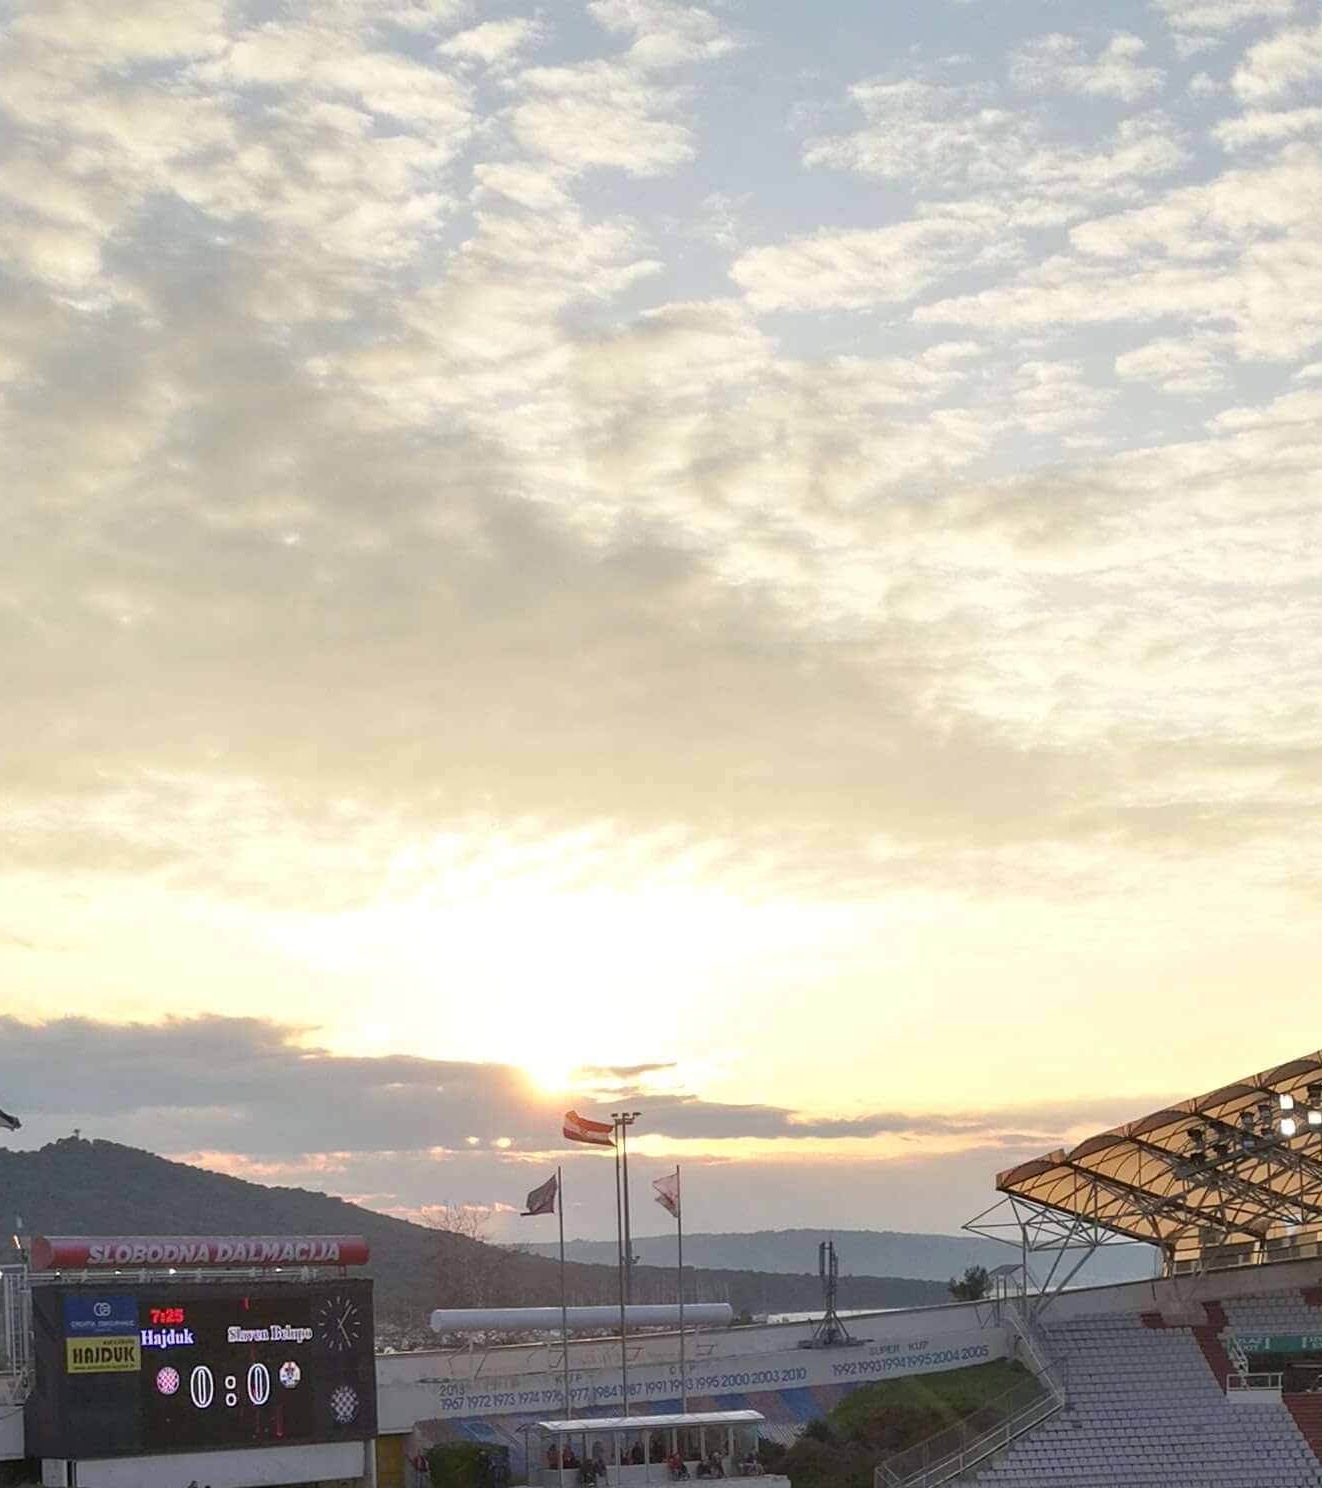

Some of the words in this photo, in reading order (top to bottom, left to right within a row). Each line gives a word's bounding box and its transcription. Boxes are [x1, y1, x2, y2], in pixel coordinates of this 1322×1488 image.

[87, 1243, 211, 1265] SLOBODNA
[214, 1242, 341, 1263] DALMACIJA
[150, 1308, 184, 1324] 7:25
[141, 1328, 194, 1348] Hajduk
[228, 1326, 269, 1343] Slaven
[73, 1346, 135, 1364] HAJDUK
[832, 1363, 858, 1377] 1992
[859, 1361, 881, 1374] 1993
[883, 1358, 906, 1371] 1994
[907, 1355, 932, 1368] 1995
[933, 1351, 960, 1365] 2004
[962, 1345, 989, 1360] 2005
[190, 1365, 214, 1408] 0
[247, 1363, 271, 1405] 0
[440, 1396, 465, 1410] 1967
[467, 1394, 491, 1408] 1972
[721, 1374, 750, 1388] 2000
[781, 1367, 807, 1382] 2010
